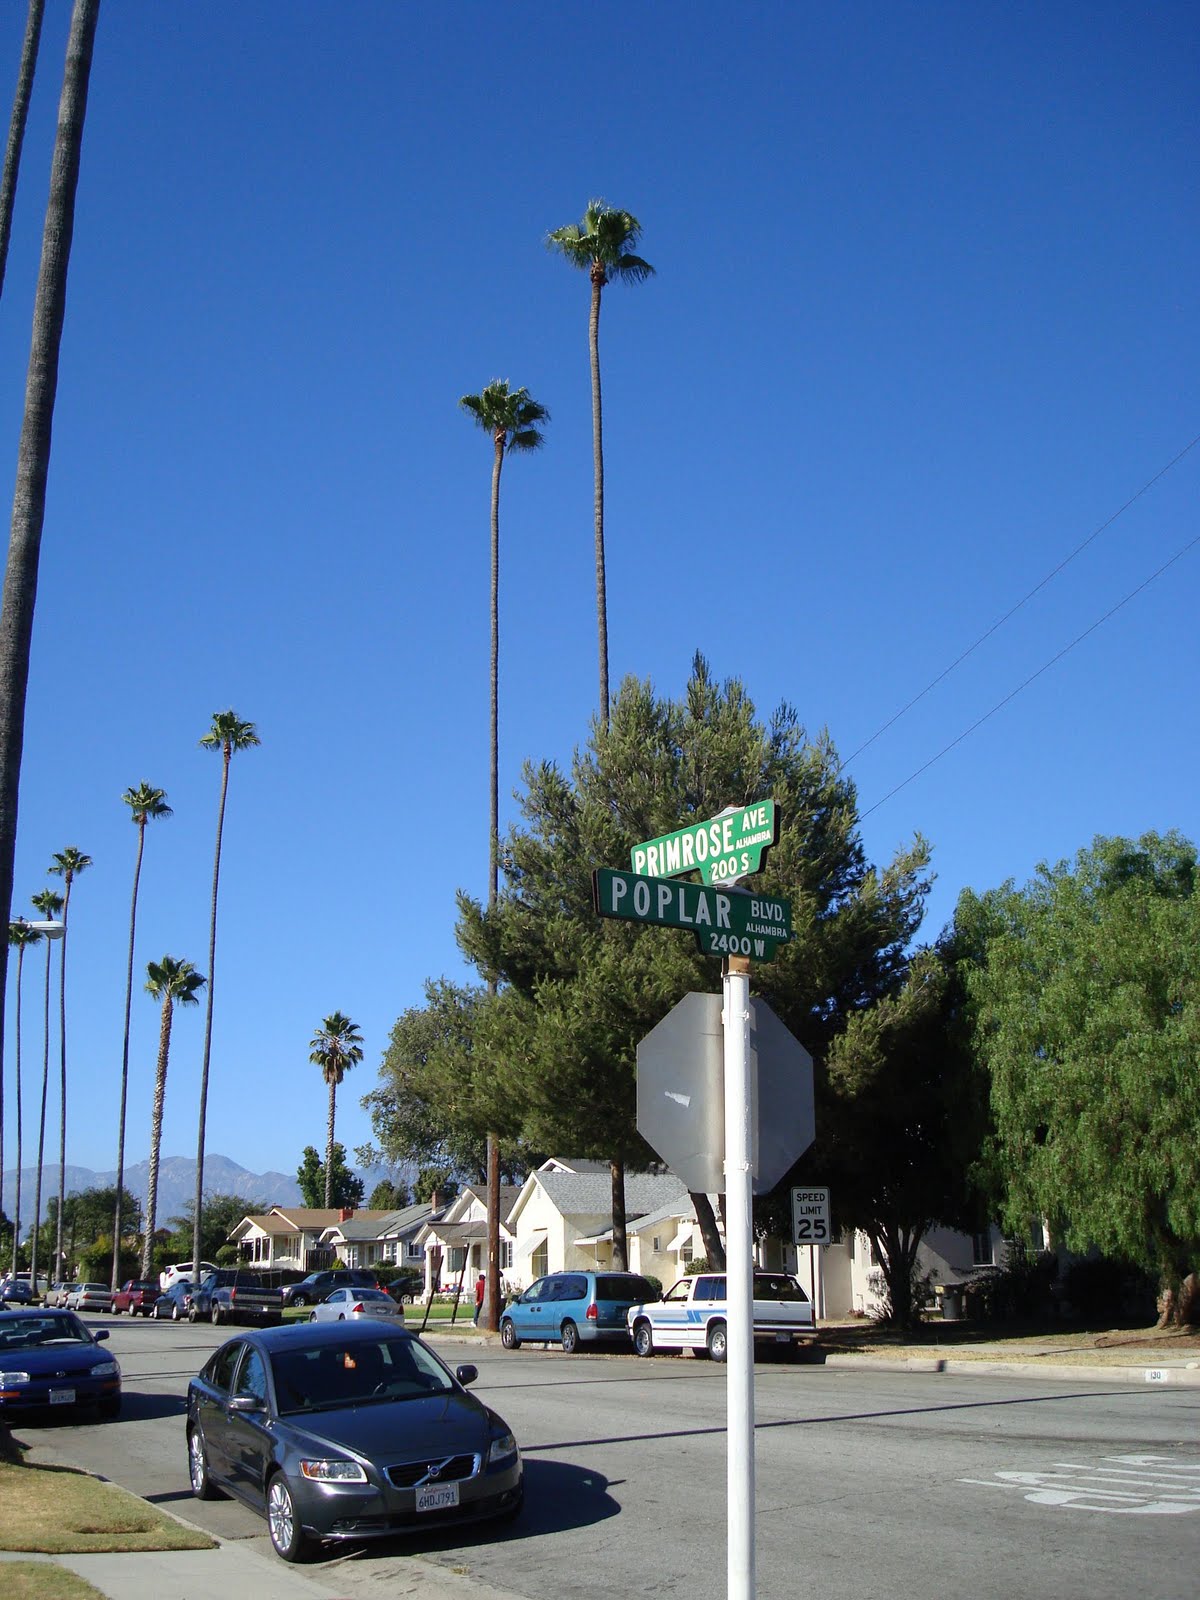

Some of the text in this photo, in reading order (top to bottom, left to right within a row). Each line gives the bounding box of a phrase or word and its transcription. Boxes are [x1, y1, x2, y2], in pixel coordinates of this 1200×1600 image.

[634, 806, 769, 877] PRIMROSE AVE.
[735, 829, 771, 850] ALHAMBRA
[710, 852, 749, 882] 200 S
[611, 876, 786, 929] POPLAR BLVD.
[746, 922, 788, 938] ALHAMBRA
[710, 933, 765, 958] 2400 W
[796, 1193, 826, 1202] SPEED
[800, 1206, 822, 1215] LIMIT
[797, 1218, 827, 1239] 25
[1150, 1371, 1161, 1380] 130
